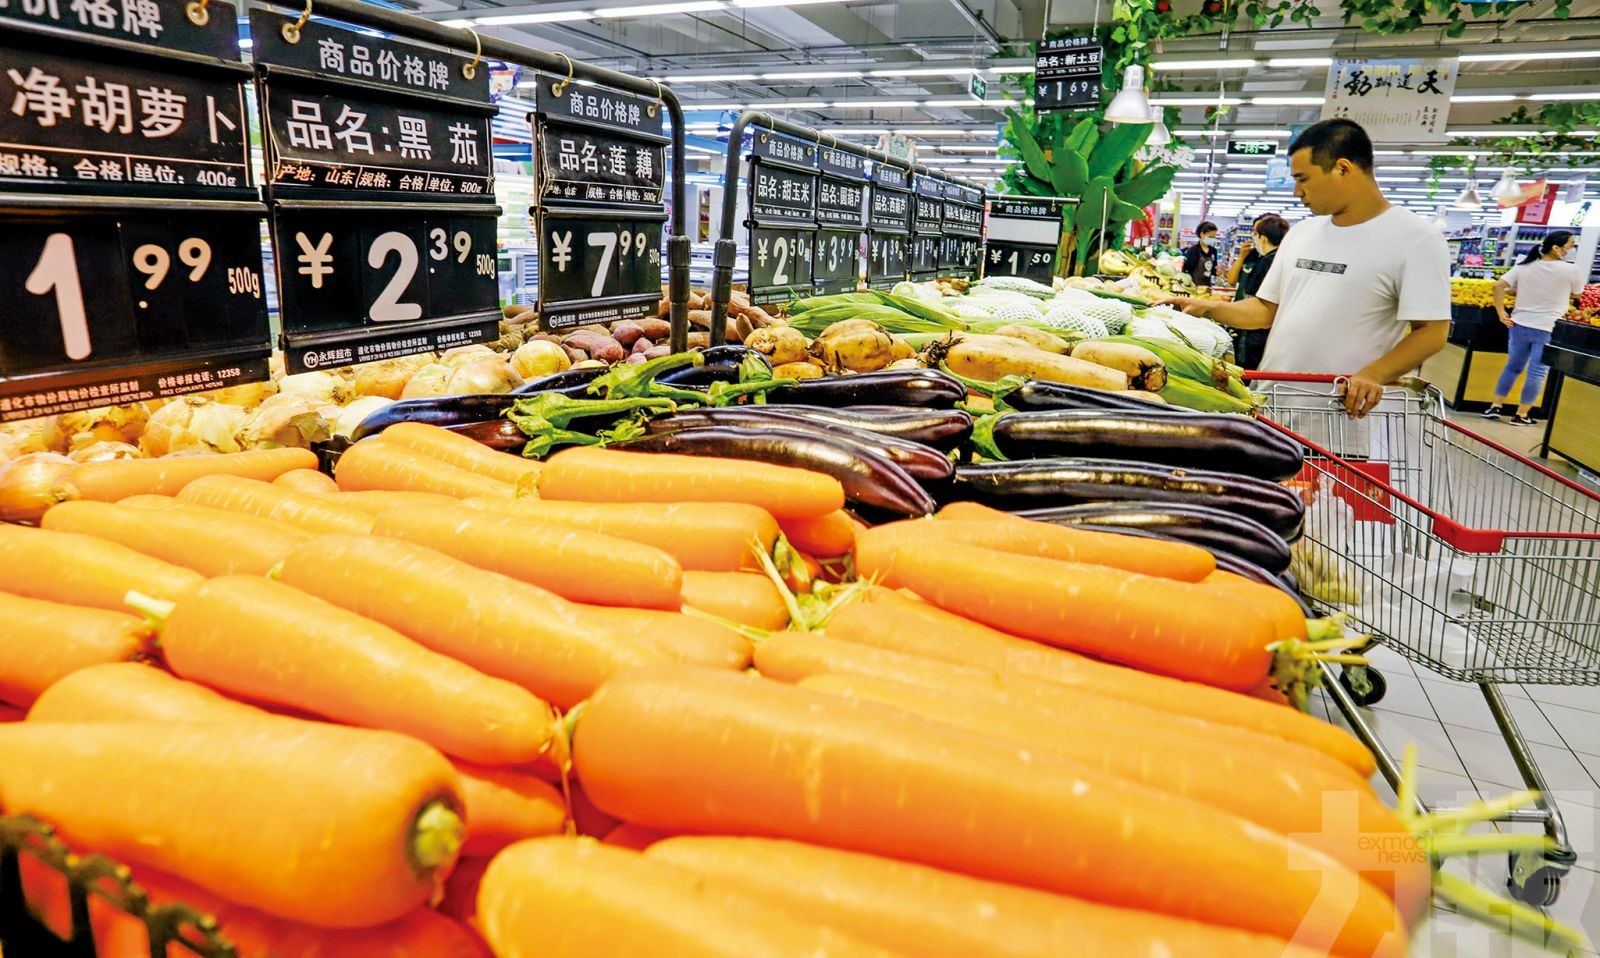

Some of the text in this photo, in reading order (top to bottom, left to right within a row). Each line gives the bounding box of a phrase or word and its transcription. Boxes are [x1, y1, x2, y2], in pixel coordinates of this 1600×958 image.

[318, 37, 450, 91] 商品价格牌
[7, 66, 237, 144] 净胡萝卜
[569, 91, 641, 126] 商品价格牌
[768, 139, 804, 162] 商品价格牌
[829, 151, 857, 170] 商品价格牌
[758, 175, 810, 203] 品名:甜玉米
[1005, 205, 1047, 215] 商品价格牌
[295, 231, 334, 289] ¥
[476, 253, 496, 280] 500g
[551, 230, 572, 272] ¥
[757, 238, 768, 267] ¥
[990, 249, 1002, 264] ¥
[228, 267, 260, 299] 500g
